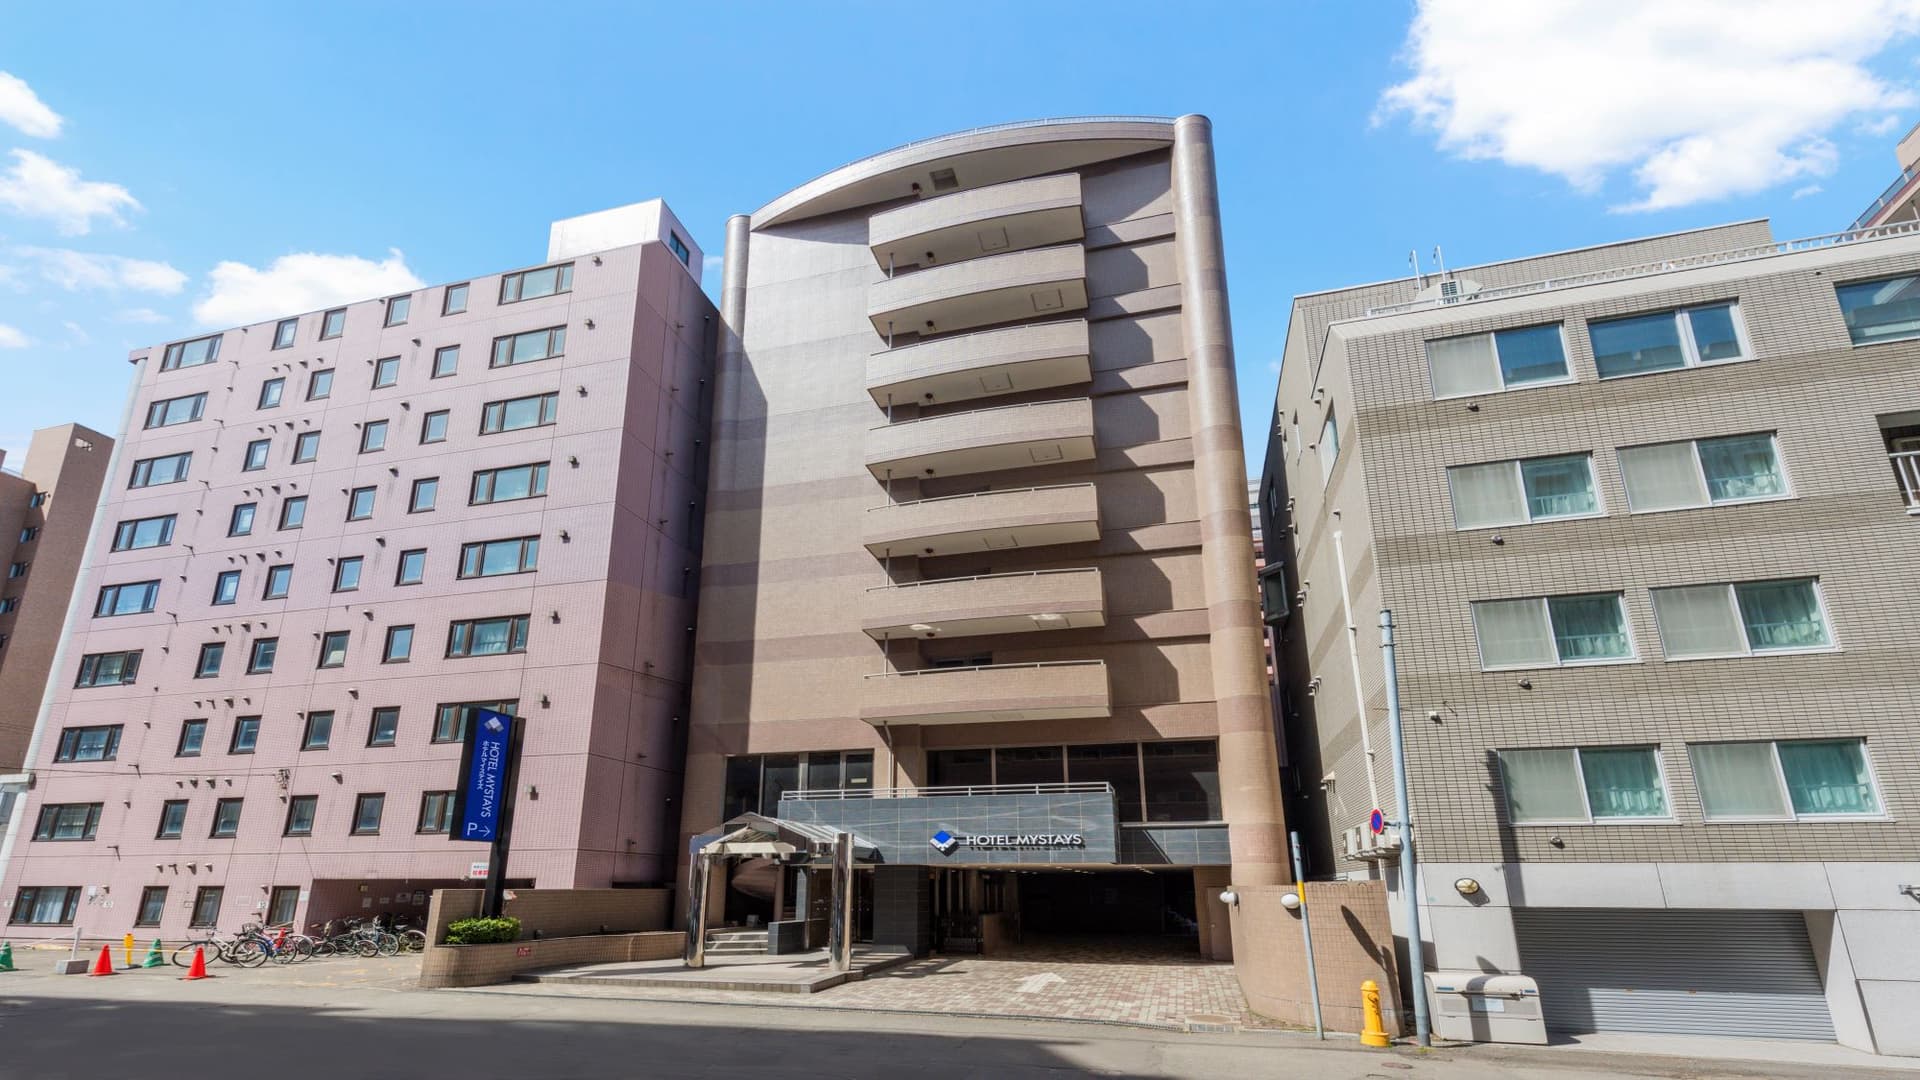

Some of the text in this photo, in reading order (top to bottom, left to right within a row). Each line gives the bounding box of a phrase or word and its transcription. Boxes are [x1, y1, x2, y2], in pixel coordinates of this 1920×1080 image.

[487, 741, 500, 771] HOTEL
[480, 773, 496, 818] MYSTAYS
[466, 822, 478, 836] P
[966, 833, 1082, 846] HOTEL MYSTAYS
